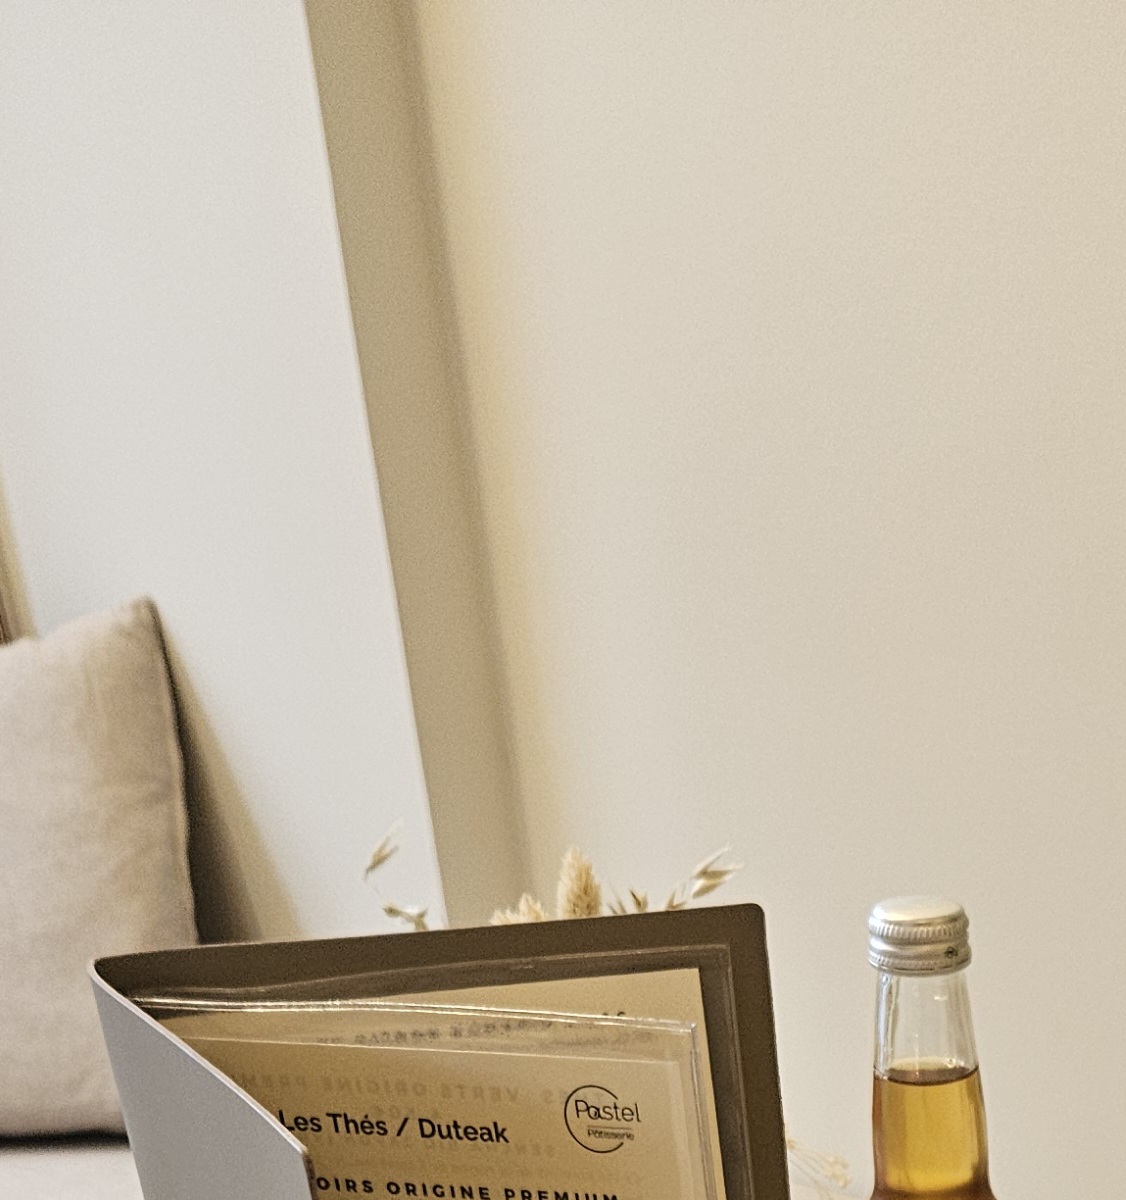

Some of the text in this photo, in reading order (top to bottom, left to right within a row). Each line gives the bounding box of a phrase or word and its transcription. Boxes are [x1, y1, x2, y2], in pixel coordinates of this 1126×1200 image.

[574, 1099, 642, 1123] Pastel
[278, 1110, 510, 1143] Les Thés / Duteak
[316, 1176, 374, 1193] OIRS
[386, 1181, 491, 1200] ORIGINE
